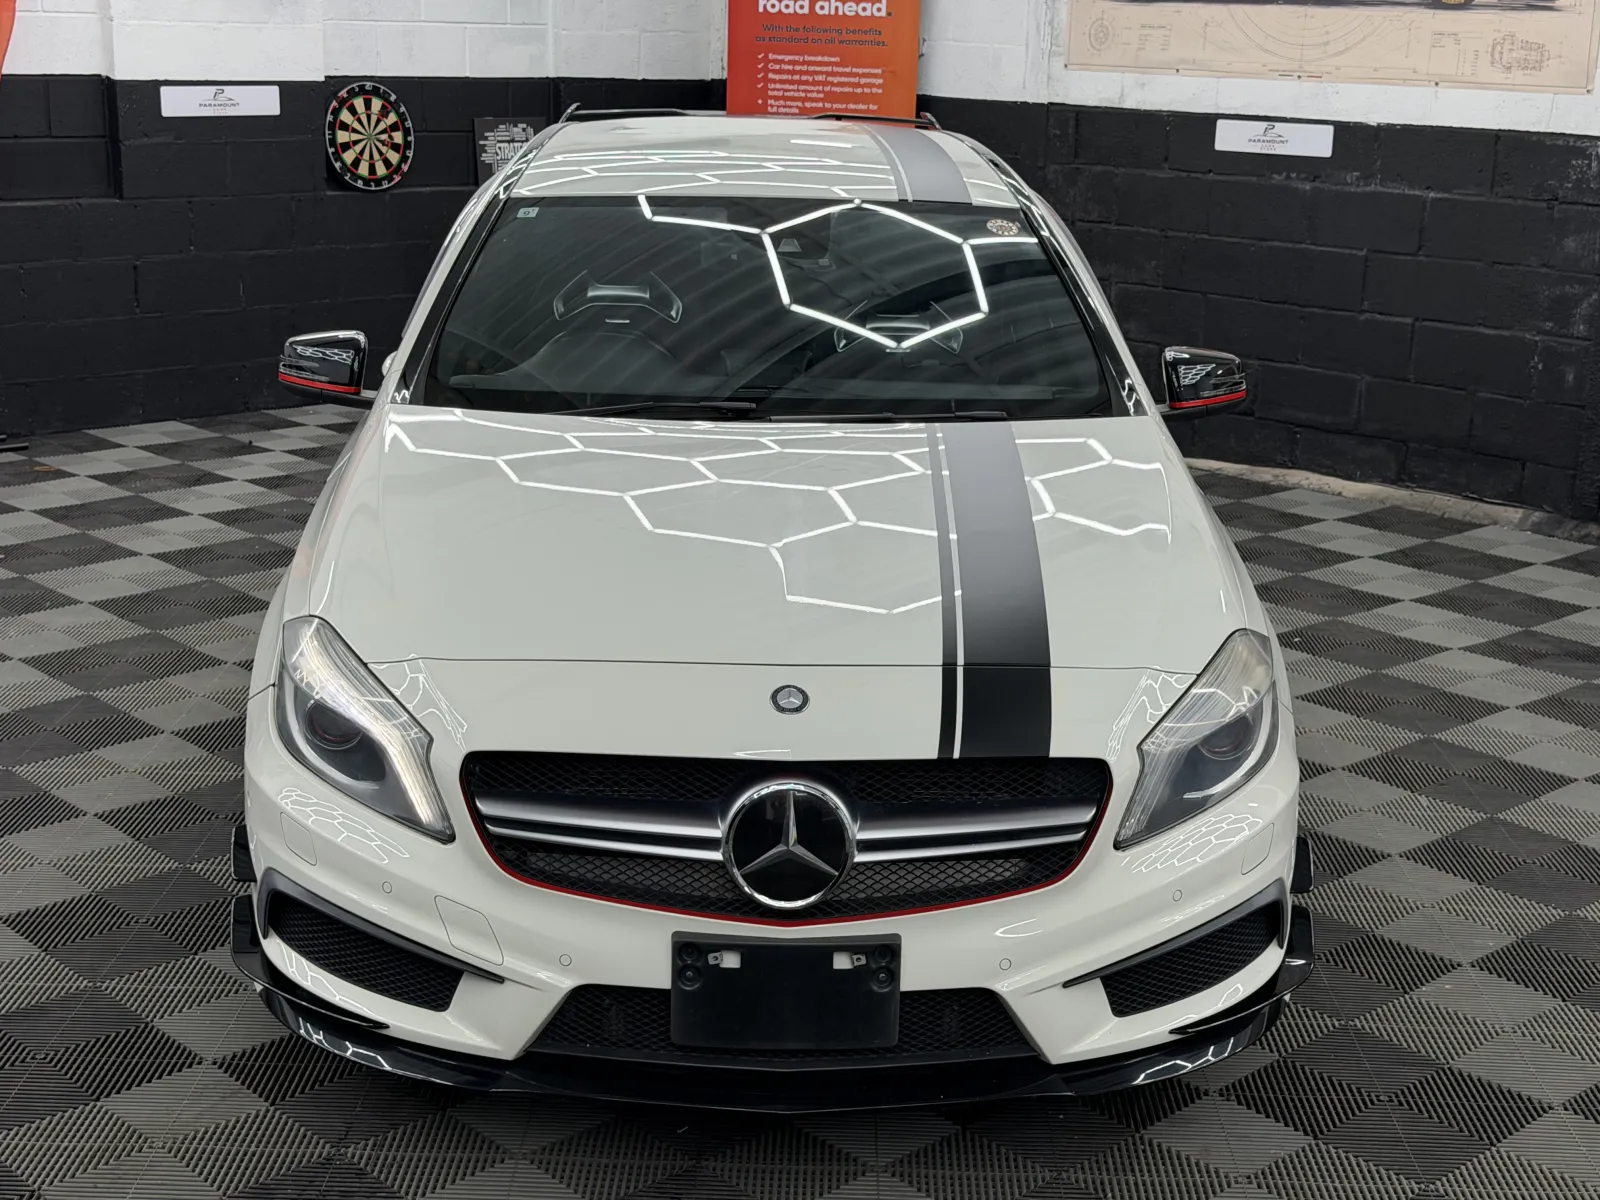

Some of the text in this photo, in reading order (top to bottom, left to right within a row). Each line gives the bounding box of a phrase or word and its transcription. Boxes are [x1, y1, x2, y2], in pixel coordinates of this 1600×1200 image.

[758, 0, 892, 17] road ahead.
[762, 23, 784, 31] With
[802, 25, 843, 37] following
[845, 27, 882, 36] benefits
[768, 35, 809, 44] standard
[838, 38, 888, 47] warranties.
[768, 53, 840, 62] Emergency breakdown
[768, 73, 792, 81] Repairs
